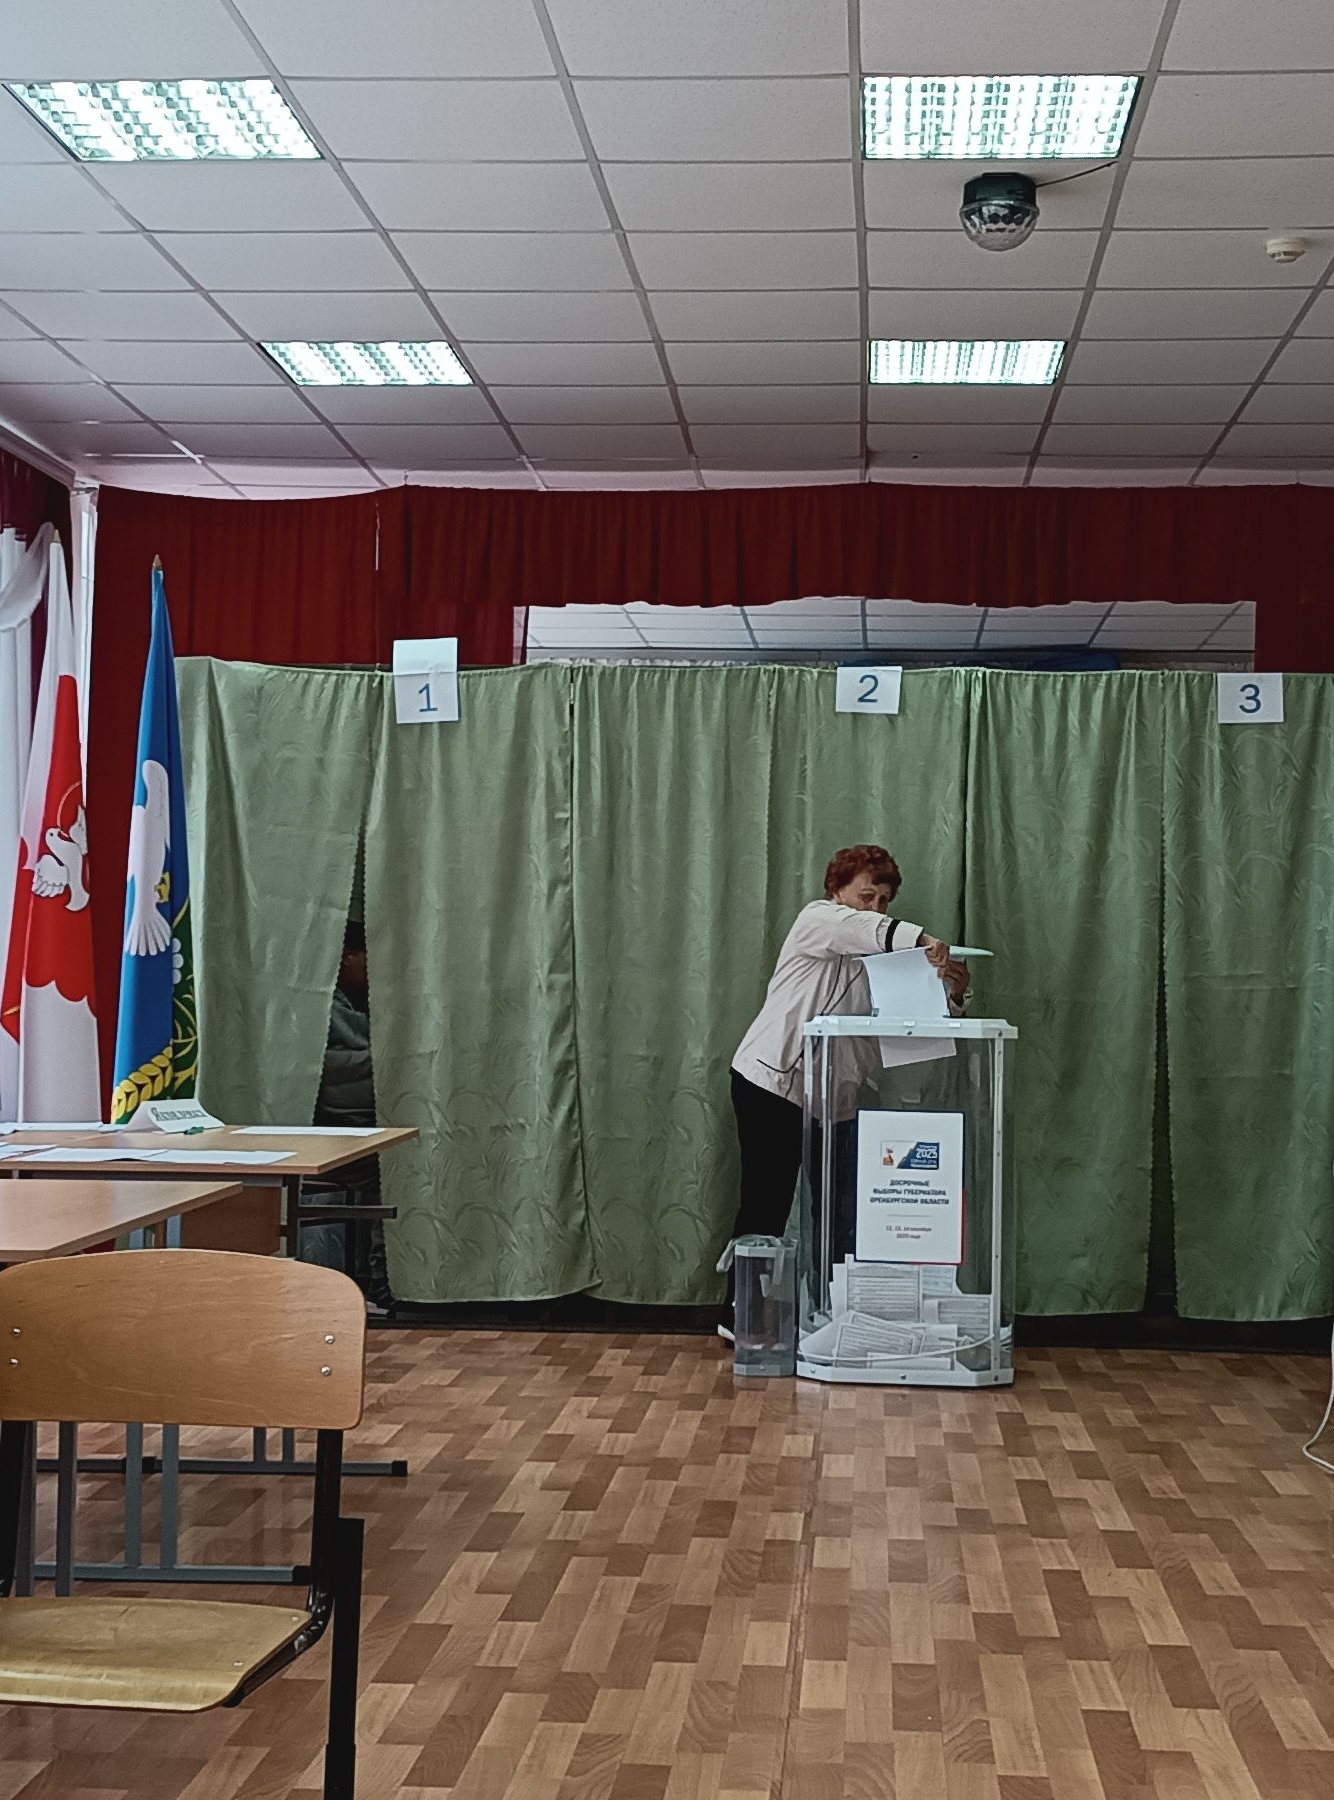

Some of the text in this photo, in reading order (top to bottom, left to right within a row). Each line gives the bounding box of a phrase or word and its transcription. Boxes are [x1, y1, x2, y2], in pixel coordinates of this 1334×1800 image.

[418, 683, 438, 713] 1
[858, 674, 878, 703] 2
[1239, 683, 1261, 713] 3
